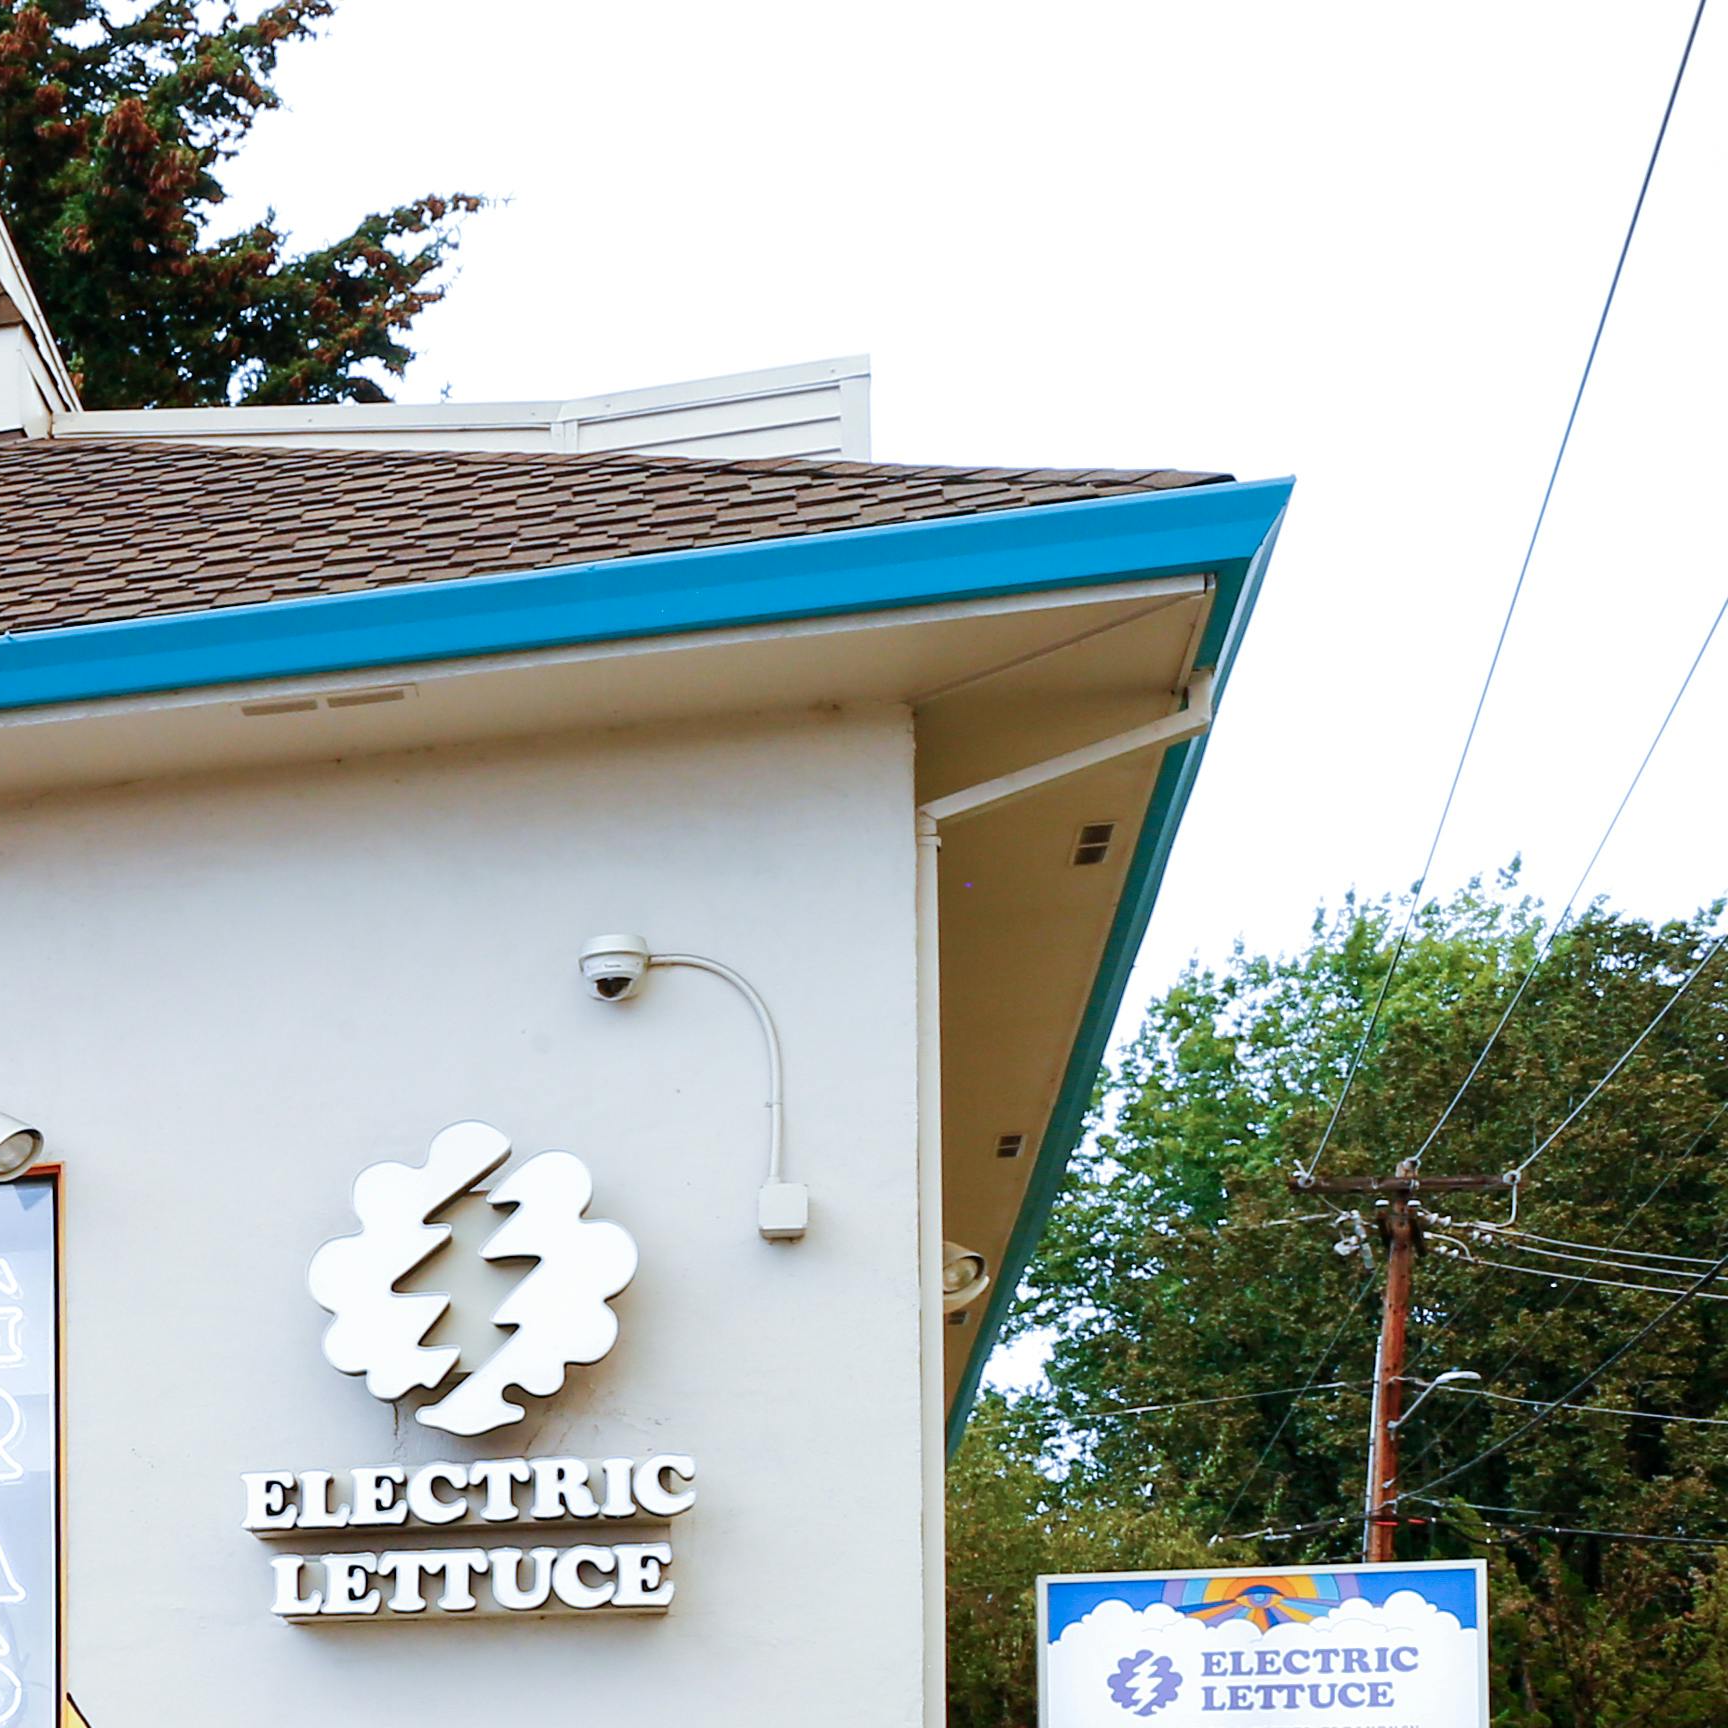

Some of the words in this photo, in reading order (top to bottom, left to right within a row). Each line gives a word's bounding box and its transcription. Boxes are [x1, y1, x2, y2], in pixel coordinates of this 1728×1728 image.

[241, 1454, 697, 1531] ELECTRIC
[271, 1542, 675, 1617] LETTUCE
[1201, 1646, 1419, 1677] ELECTRIC
[1201, 1682, 1394, 1711] LETTUCE
